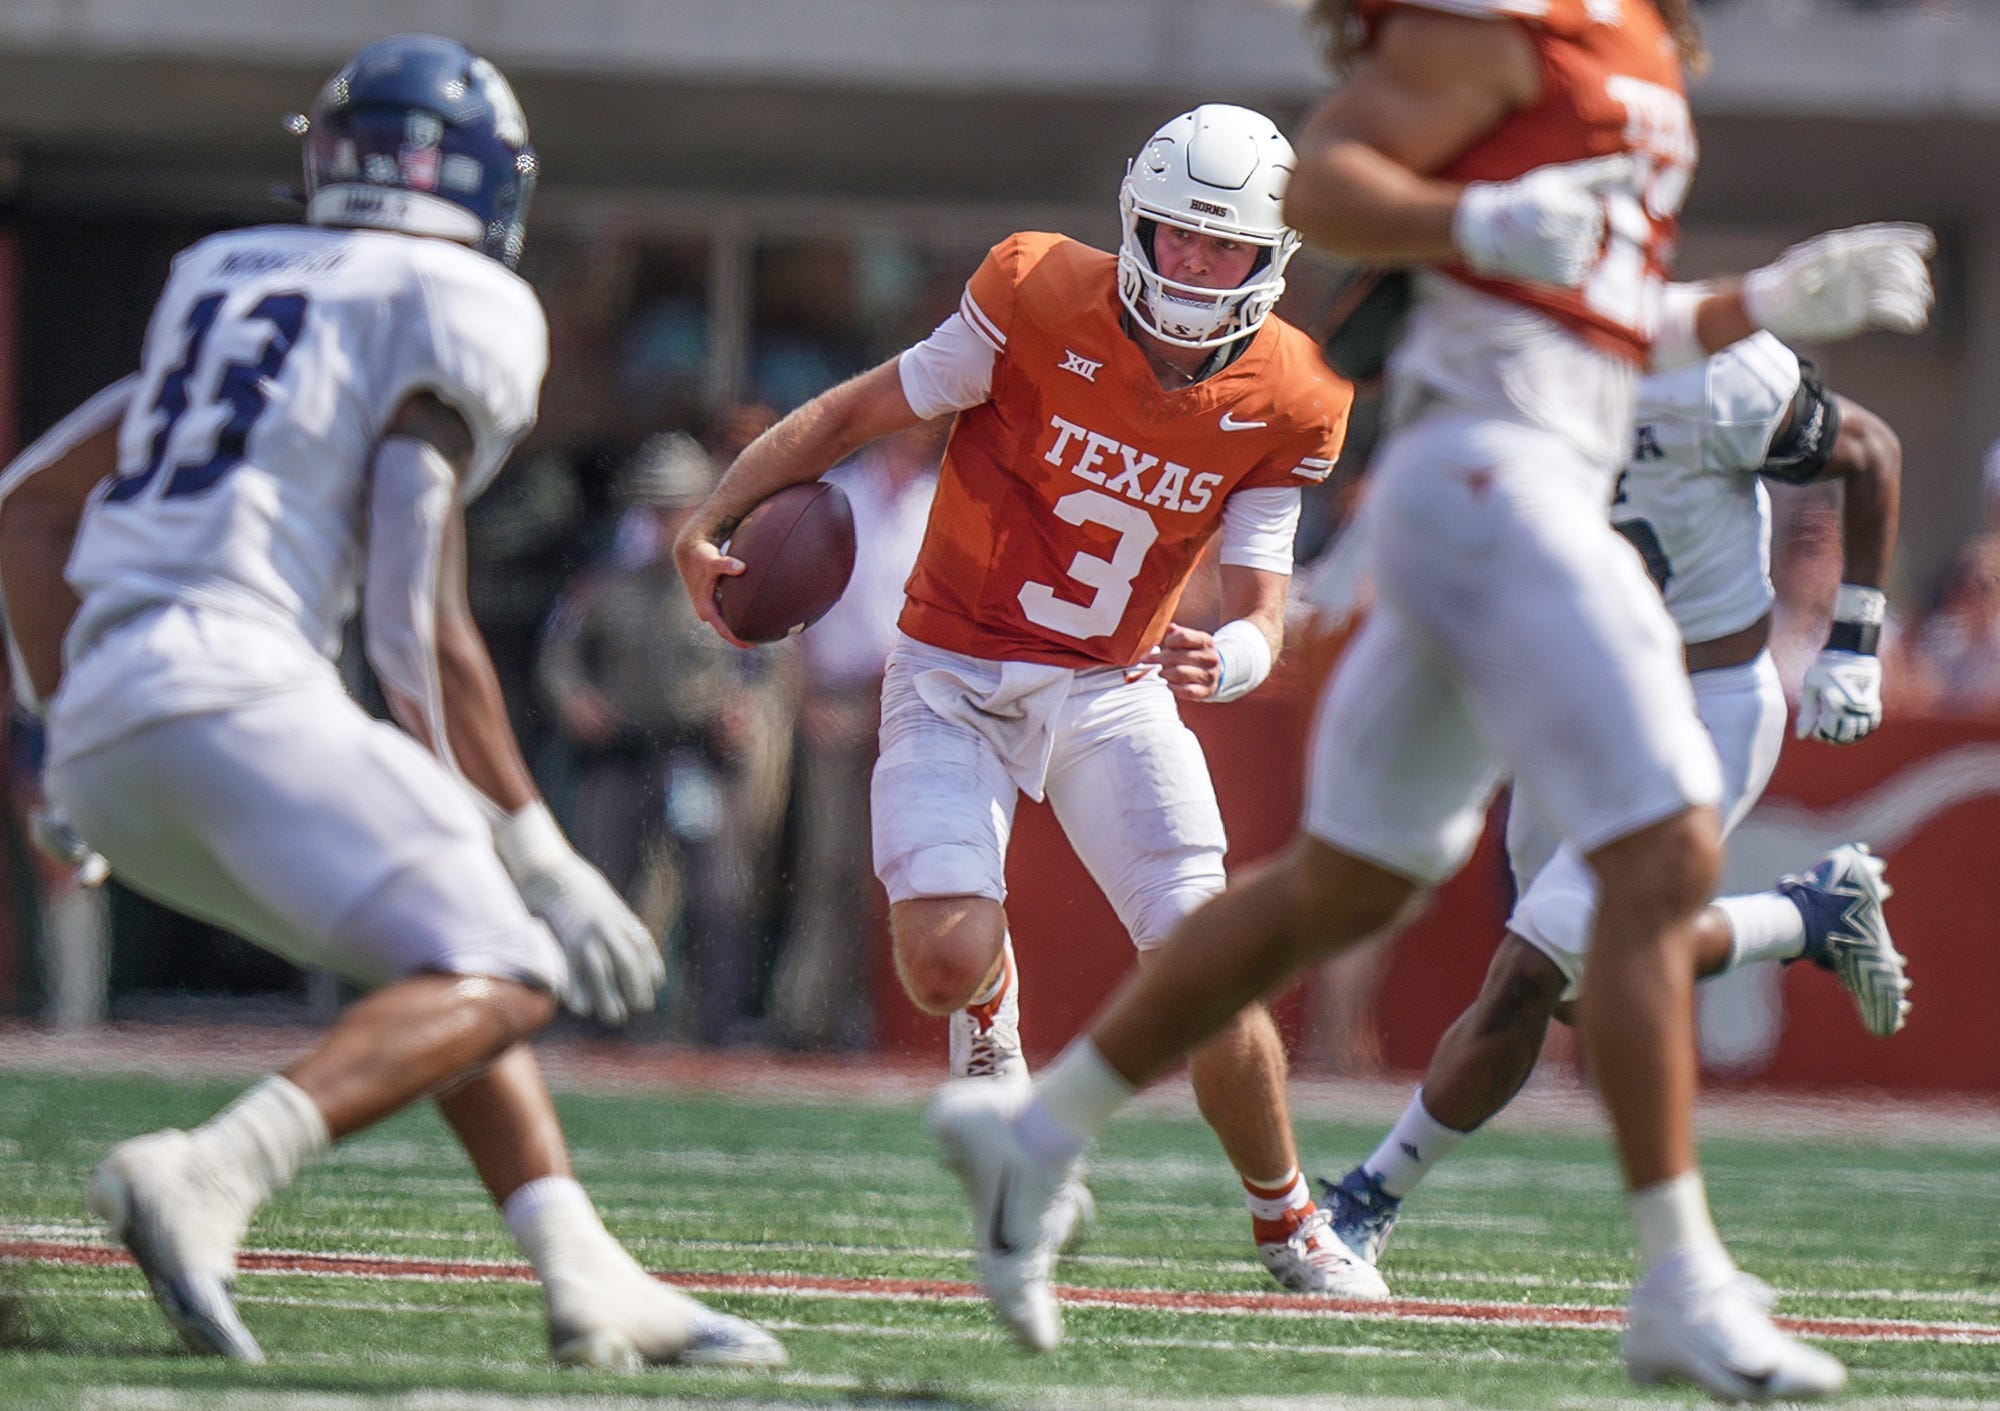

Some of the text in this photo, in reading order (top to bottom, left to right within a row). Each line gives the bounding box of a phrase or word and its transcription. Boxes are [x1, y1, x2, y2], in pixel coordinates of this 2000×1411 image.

[1190, 199, 1228, 218] HORNS
[1057, 349, 1104, 383] XII
[1044, 414, 1224, 514] TEXAS
[1017, 489, 1159, 641] 3
